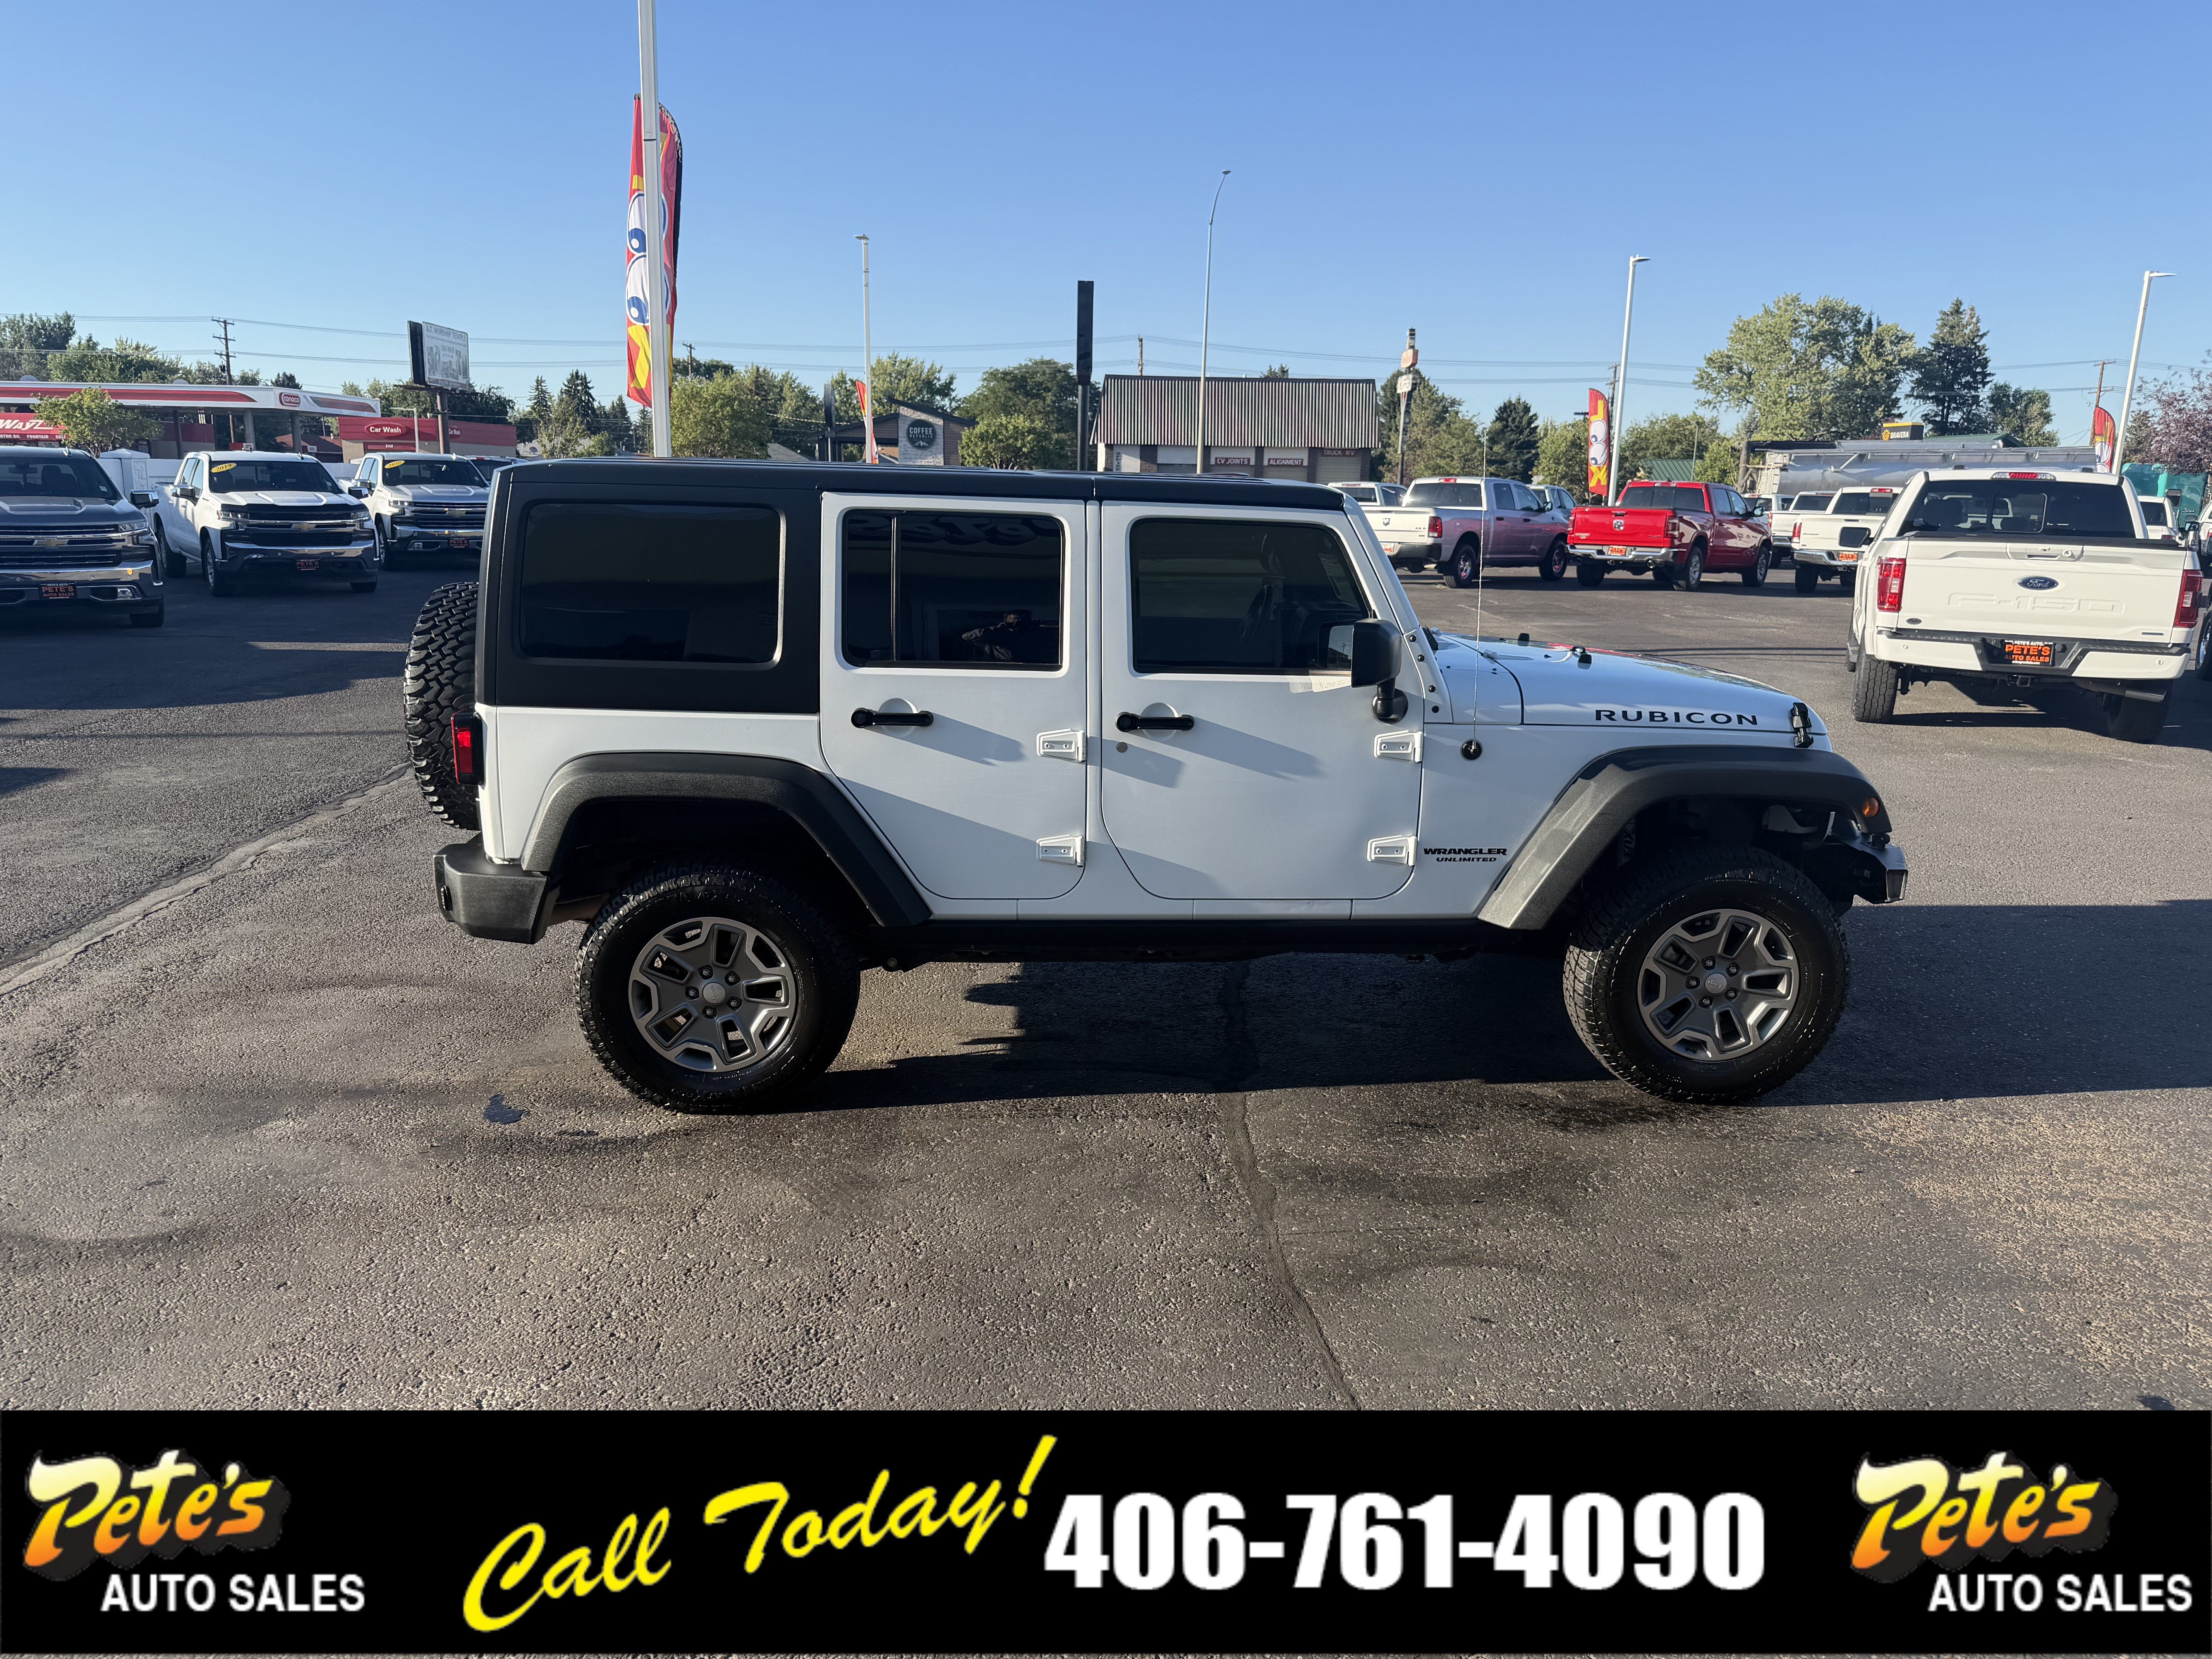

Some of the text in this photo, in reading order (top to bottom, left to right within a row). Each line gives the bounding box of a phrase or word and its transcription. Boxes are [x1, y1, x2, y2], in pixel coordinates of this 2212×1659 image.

[2027, 579, 2050, 588] Ford
[1948, 592, 2126, 615] F-150
[2005, 644, 2050, 656] PETE'S
[1595, 709, 1758, 725] RUBICON
